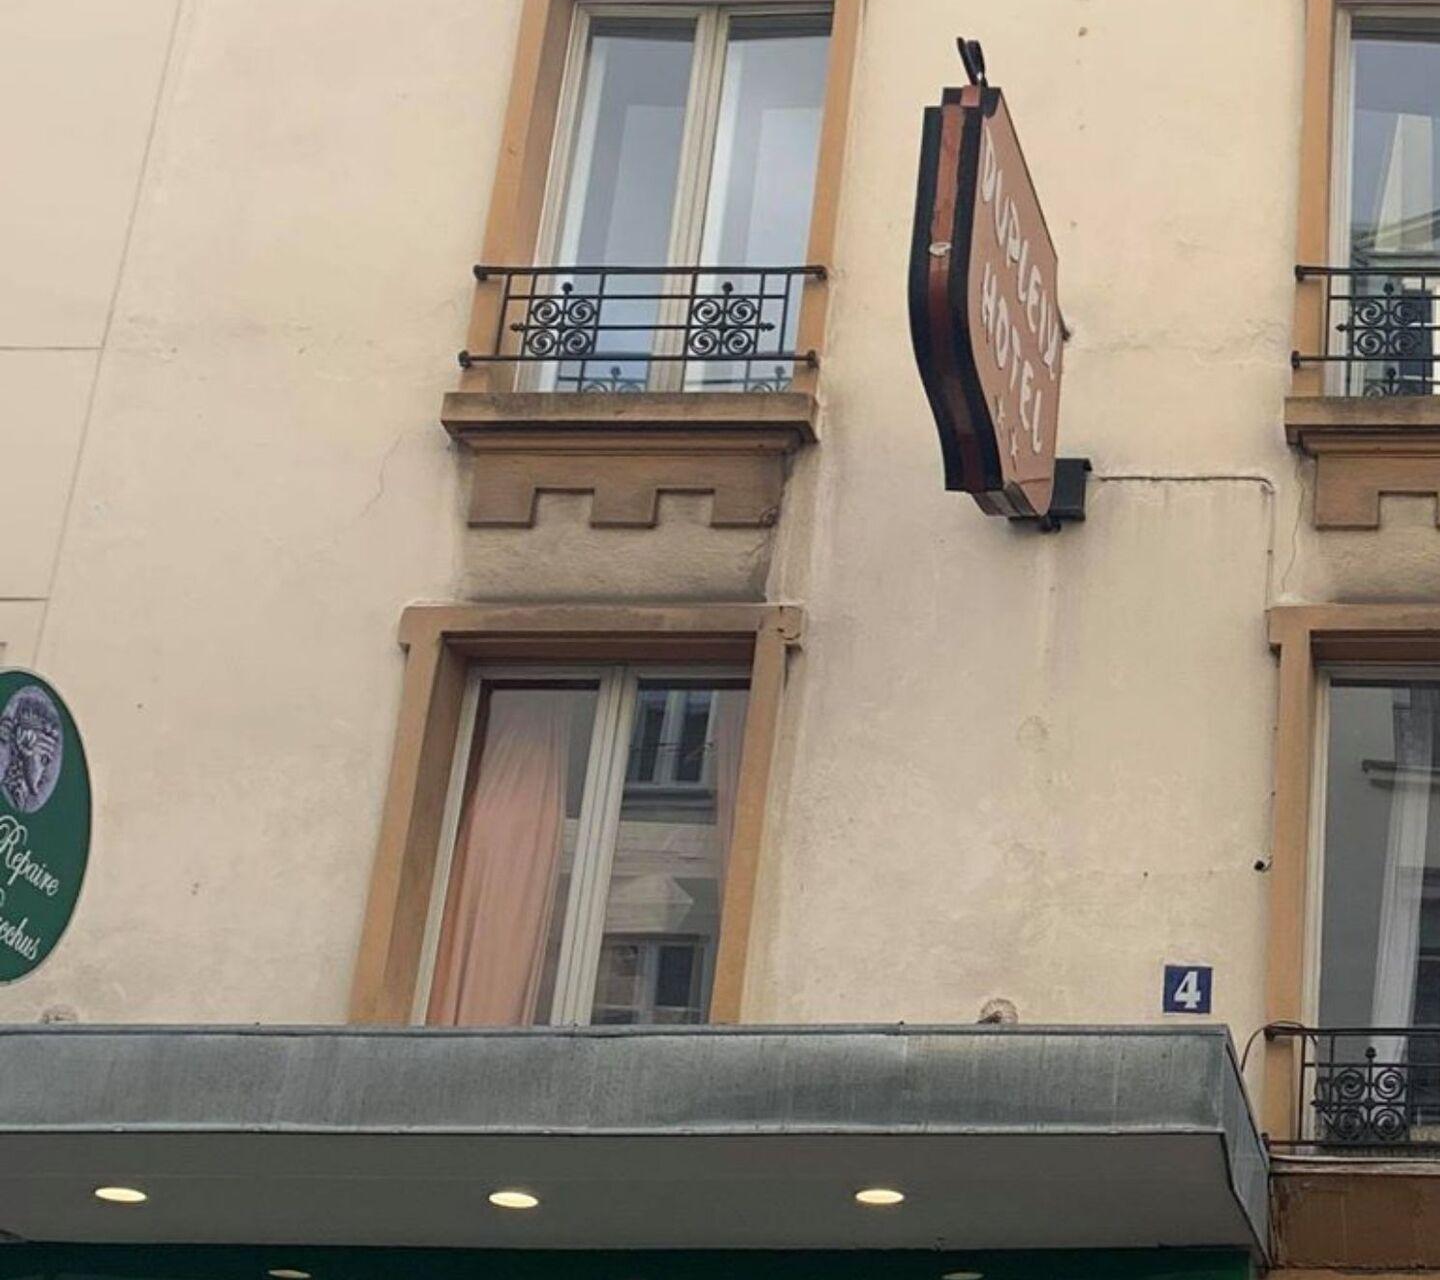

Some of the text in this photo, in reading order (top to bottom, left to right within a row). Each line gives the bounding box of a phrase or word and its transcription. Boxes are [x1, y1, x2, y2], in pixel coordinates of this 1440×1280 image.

[982, 124, 1061, 381] DUPLEIX
[983, 263, 1042, 453] HOTEL
[0, 815, 59, 896] Repaire
[1174, 971, 1201, 1009] 4
